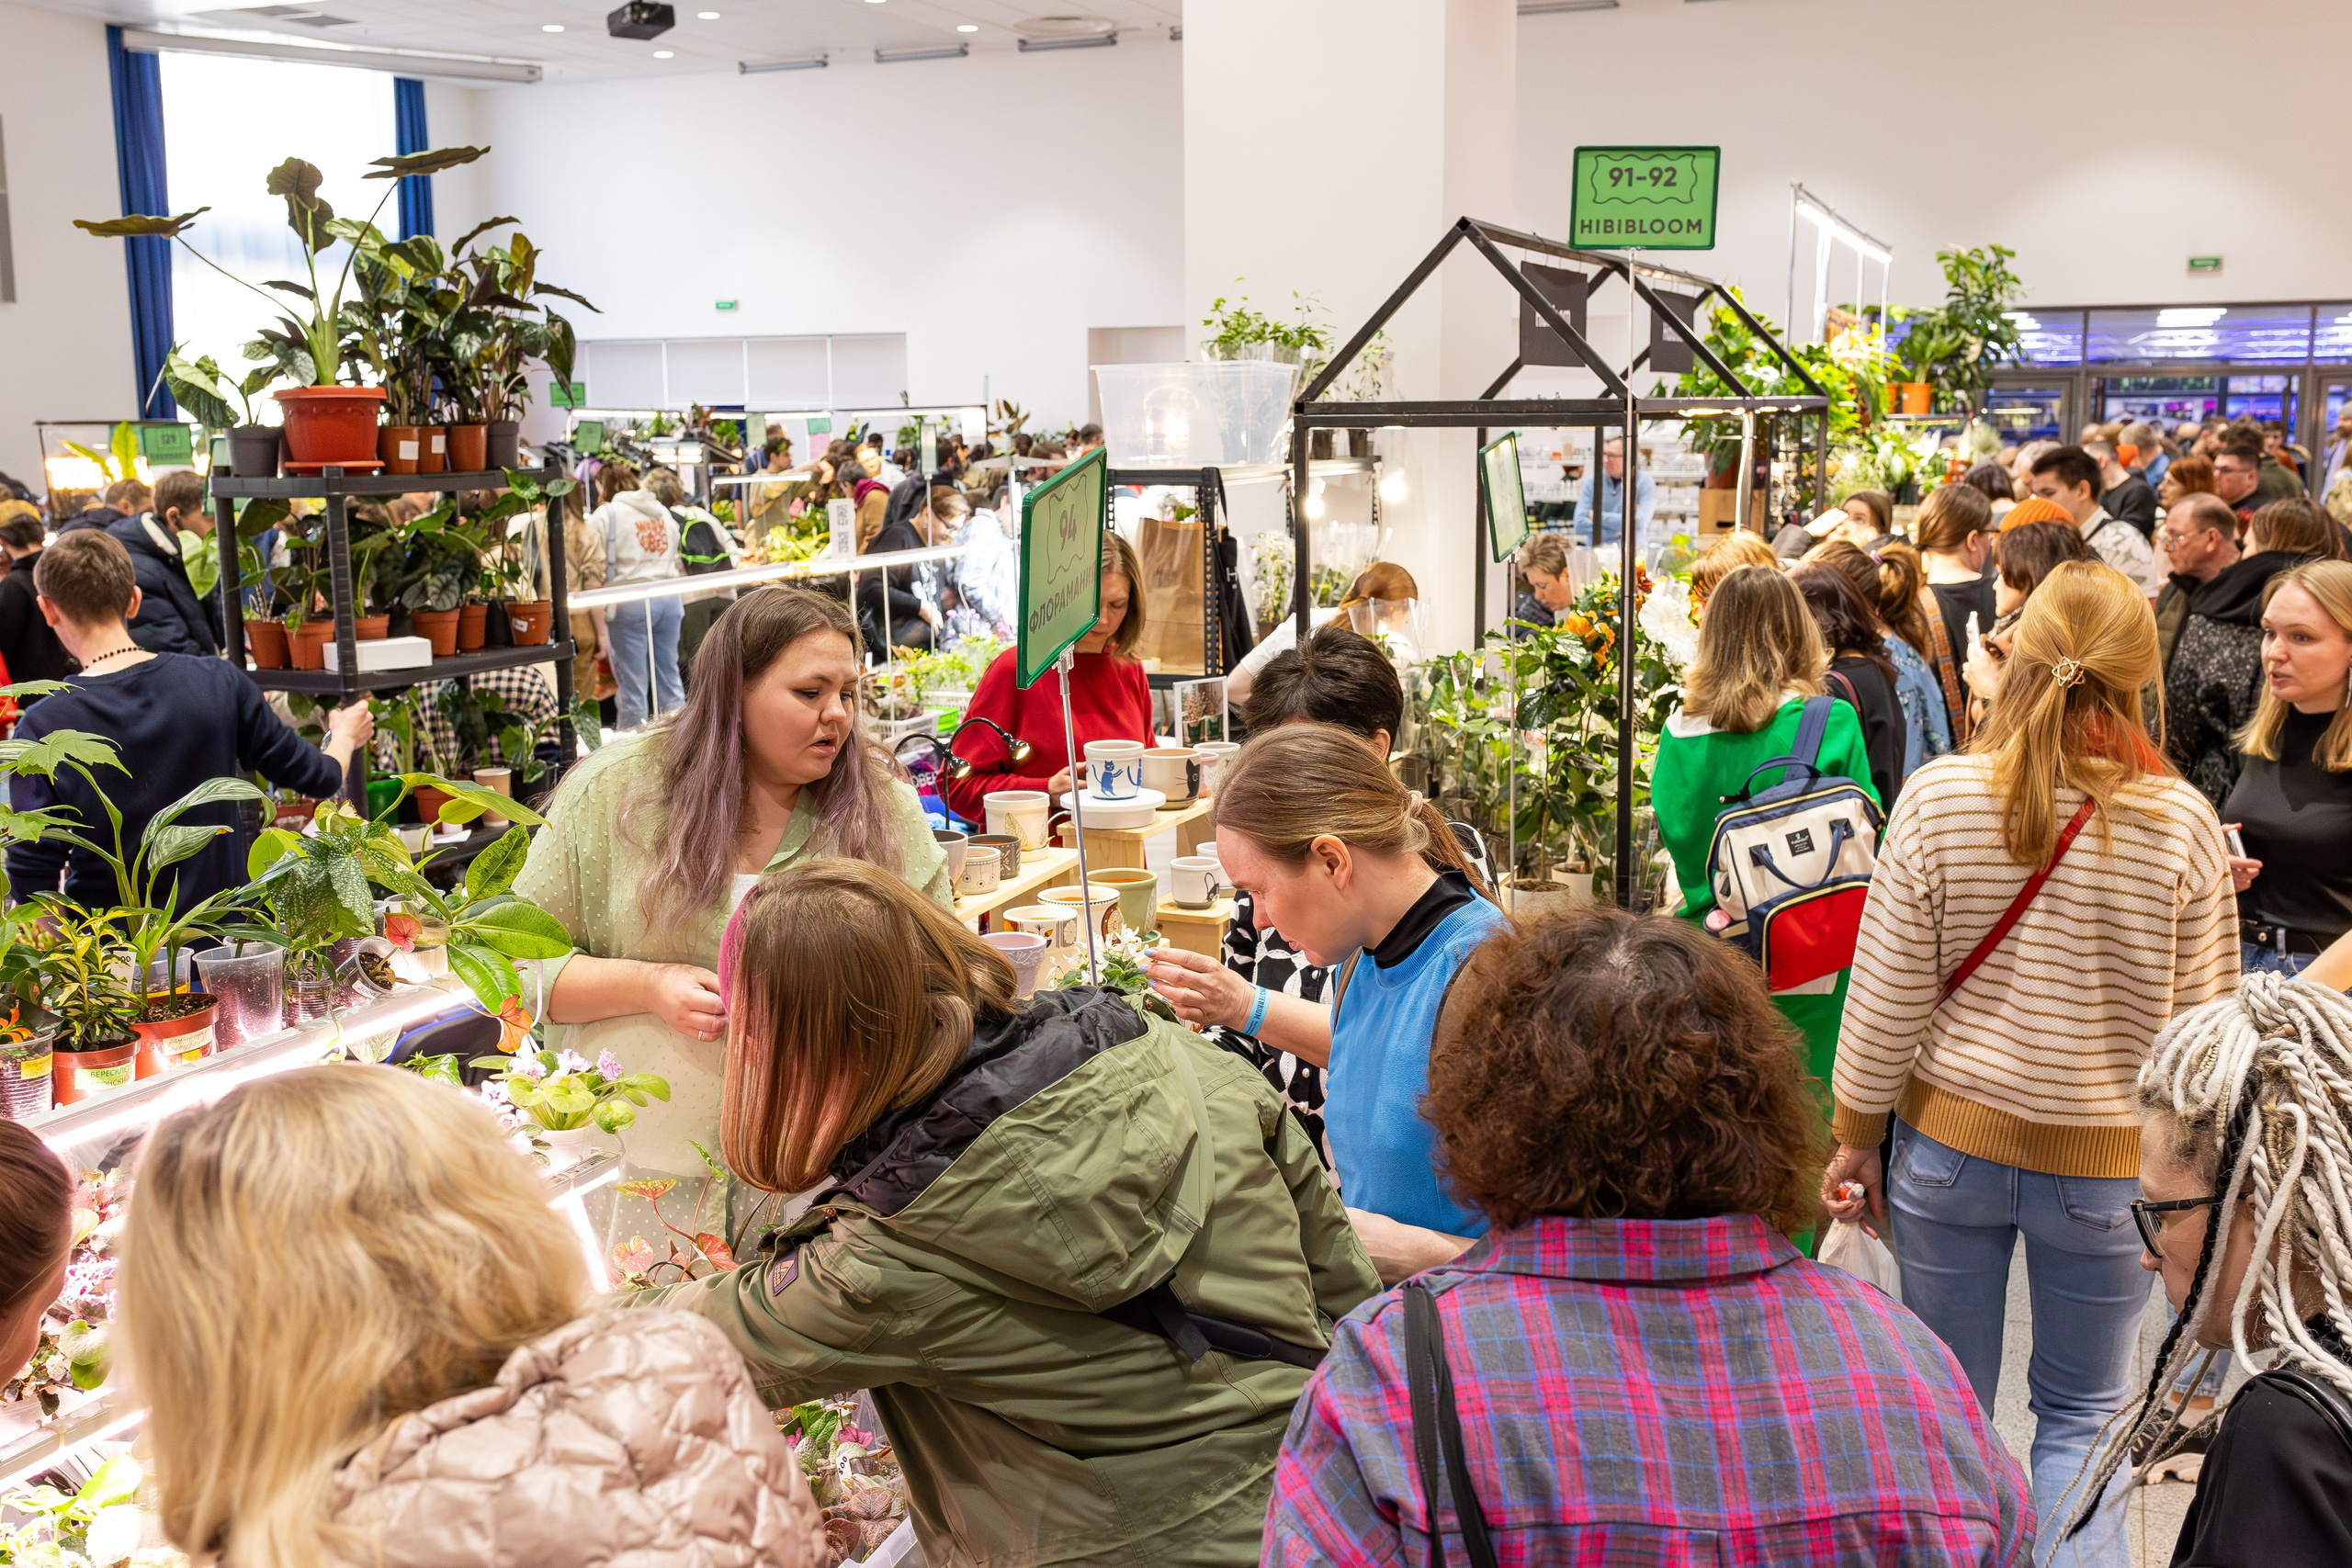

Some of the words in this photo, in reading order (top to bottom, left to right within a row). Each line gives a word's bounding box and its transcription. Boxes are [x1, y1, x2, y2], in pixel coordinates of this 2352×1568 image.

[1609, 166, 1677, 187] 91-92
[1580, 219, 1702, 234] HIBIBLOOM
[1059, 503, 1077, 551] 94
